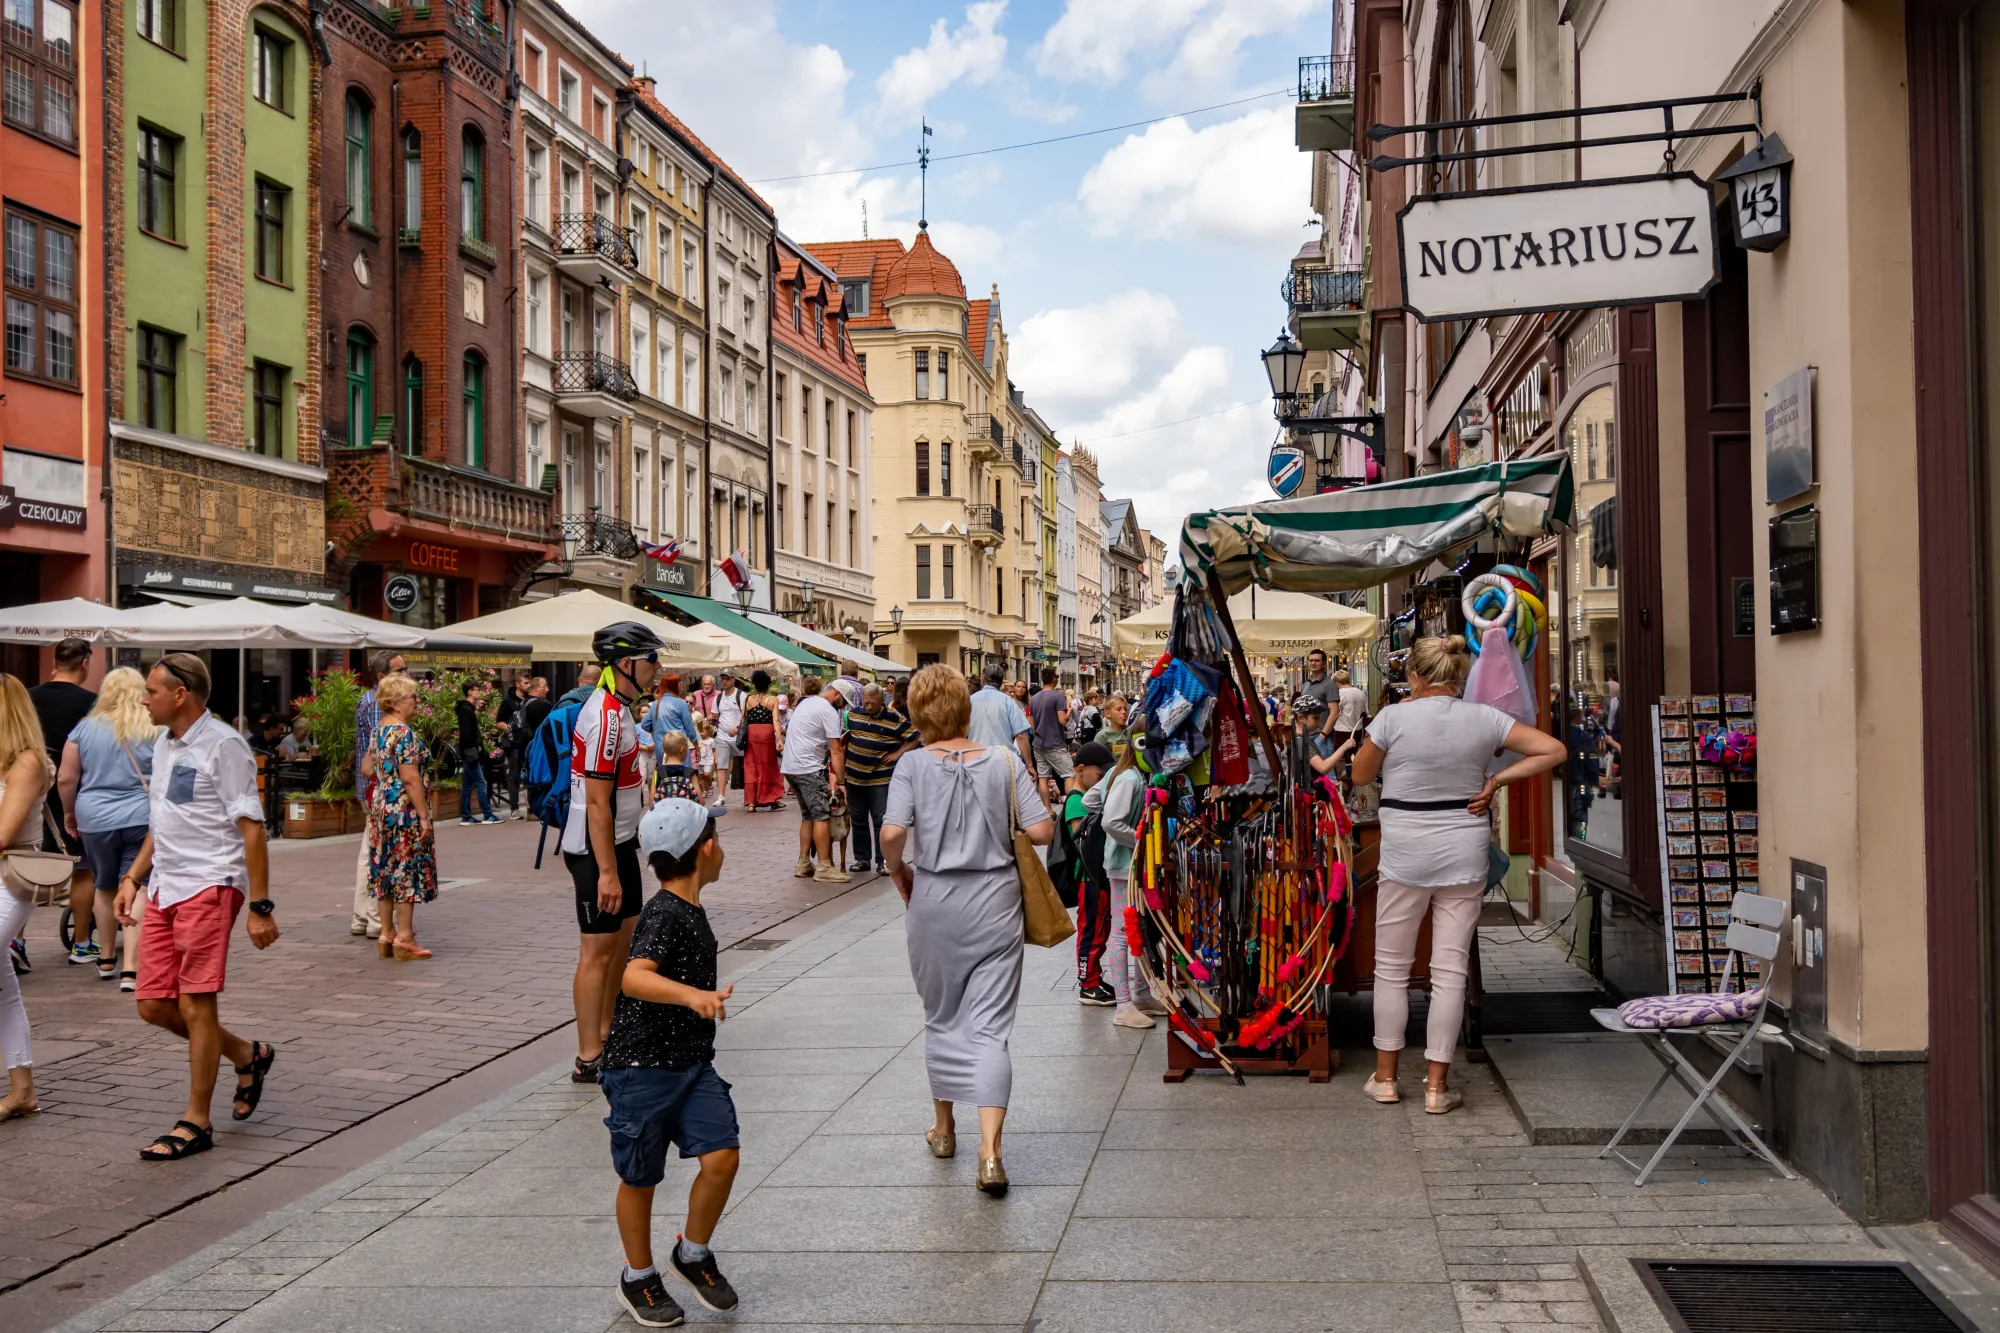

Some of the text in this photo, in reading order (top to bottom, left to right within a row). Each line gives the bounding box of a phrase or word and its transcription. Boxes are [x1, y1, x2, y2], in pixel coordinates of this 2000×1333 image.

[1741, 183, 1778, 221] 43
[1418, 216, 1699, 278] NOTARIUSZ
[19, 502, 82, 525] CZEKOLADY
[410, 542, 458, 571] COFFEE
[656, 562, 685, 586] Bangkok
[15, 626, 40, 636] KAWA
[63, 628, 97, 639] DESERY
[607, 711, 618, 747] VITESSE
